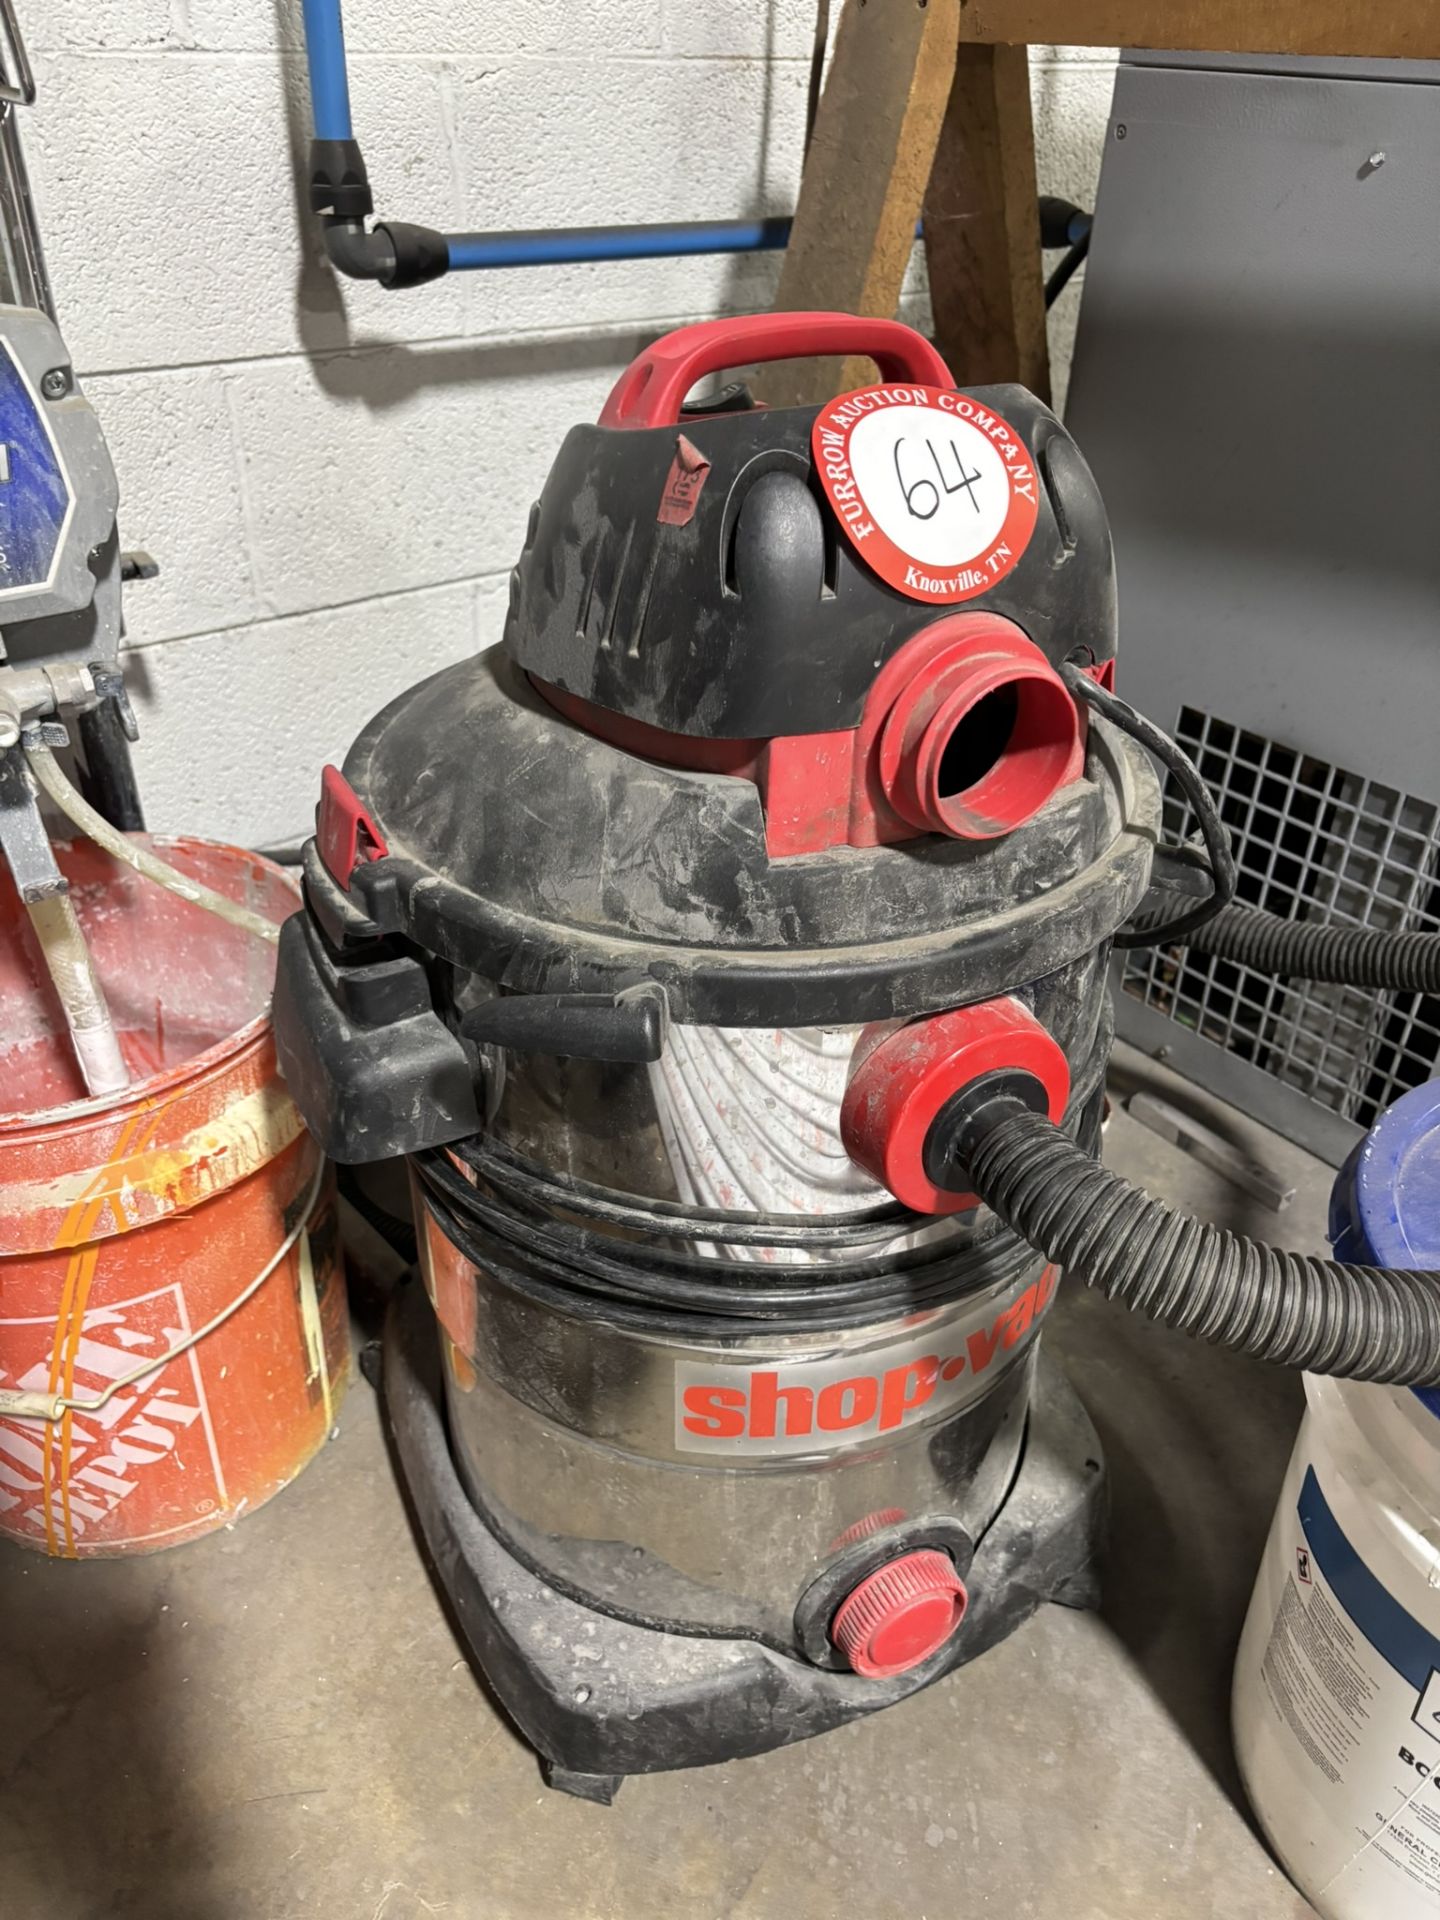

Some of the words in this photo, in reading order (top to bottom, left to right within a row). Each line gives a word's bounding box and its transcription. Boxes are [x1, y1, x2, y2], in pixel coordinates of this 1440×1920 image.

[829, 388, 929, 430] AUCTION
[938, 394, 1036, 504] COMPANY
[820, 425, 875, 541] FURROW
[894, 437, 982, 520] 64
[903, 565, 988, 594] Knoxville,
[985, 541, 1013, 574] TN
